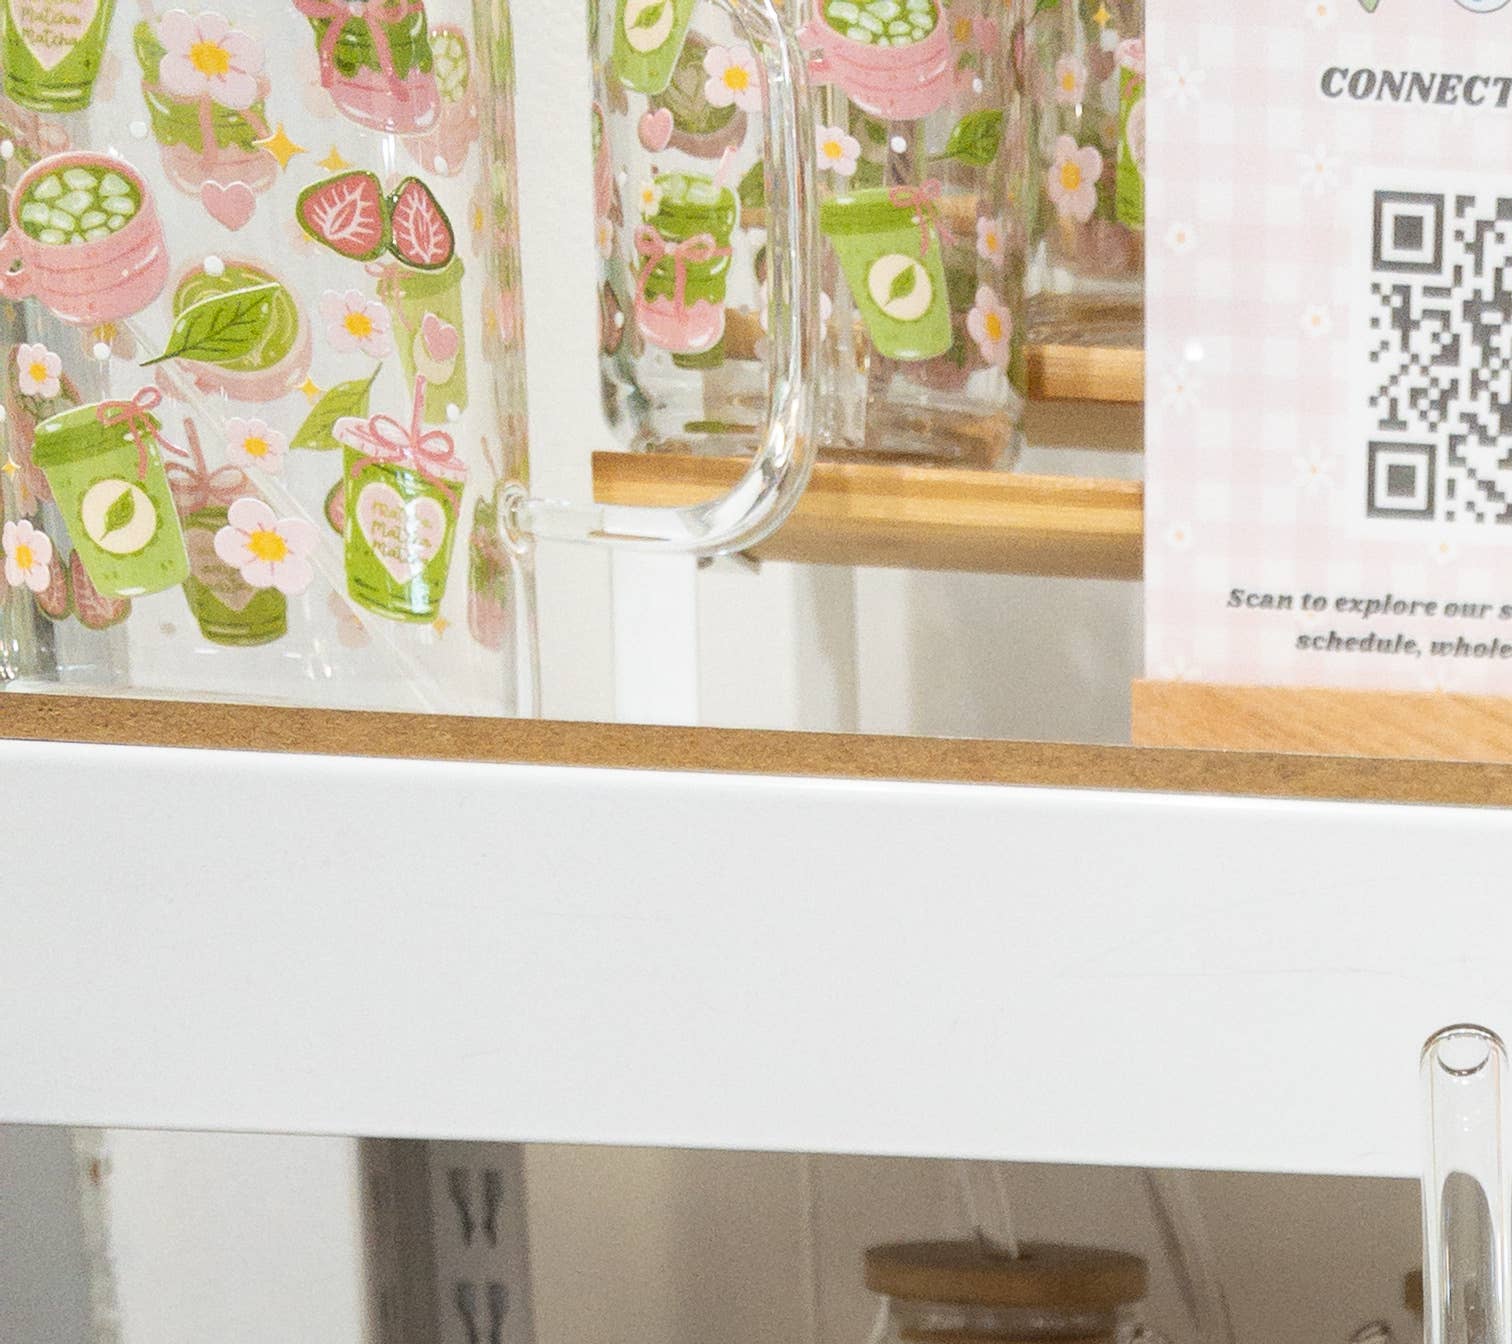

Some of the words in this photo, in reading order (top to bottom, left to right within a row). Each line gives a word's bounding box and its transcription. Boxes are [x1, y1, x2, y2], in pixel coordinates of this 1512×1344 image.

[1227, 587, 1294, 611] Scan
[1300, 592, 1328, 613] to
[1334, 593, 1438, 620] explore
[1443, 600, 1493, 620] our
[1295, 630, 1423, 658] schedule,
